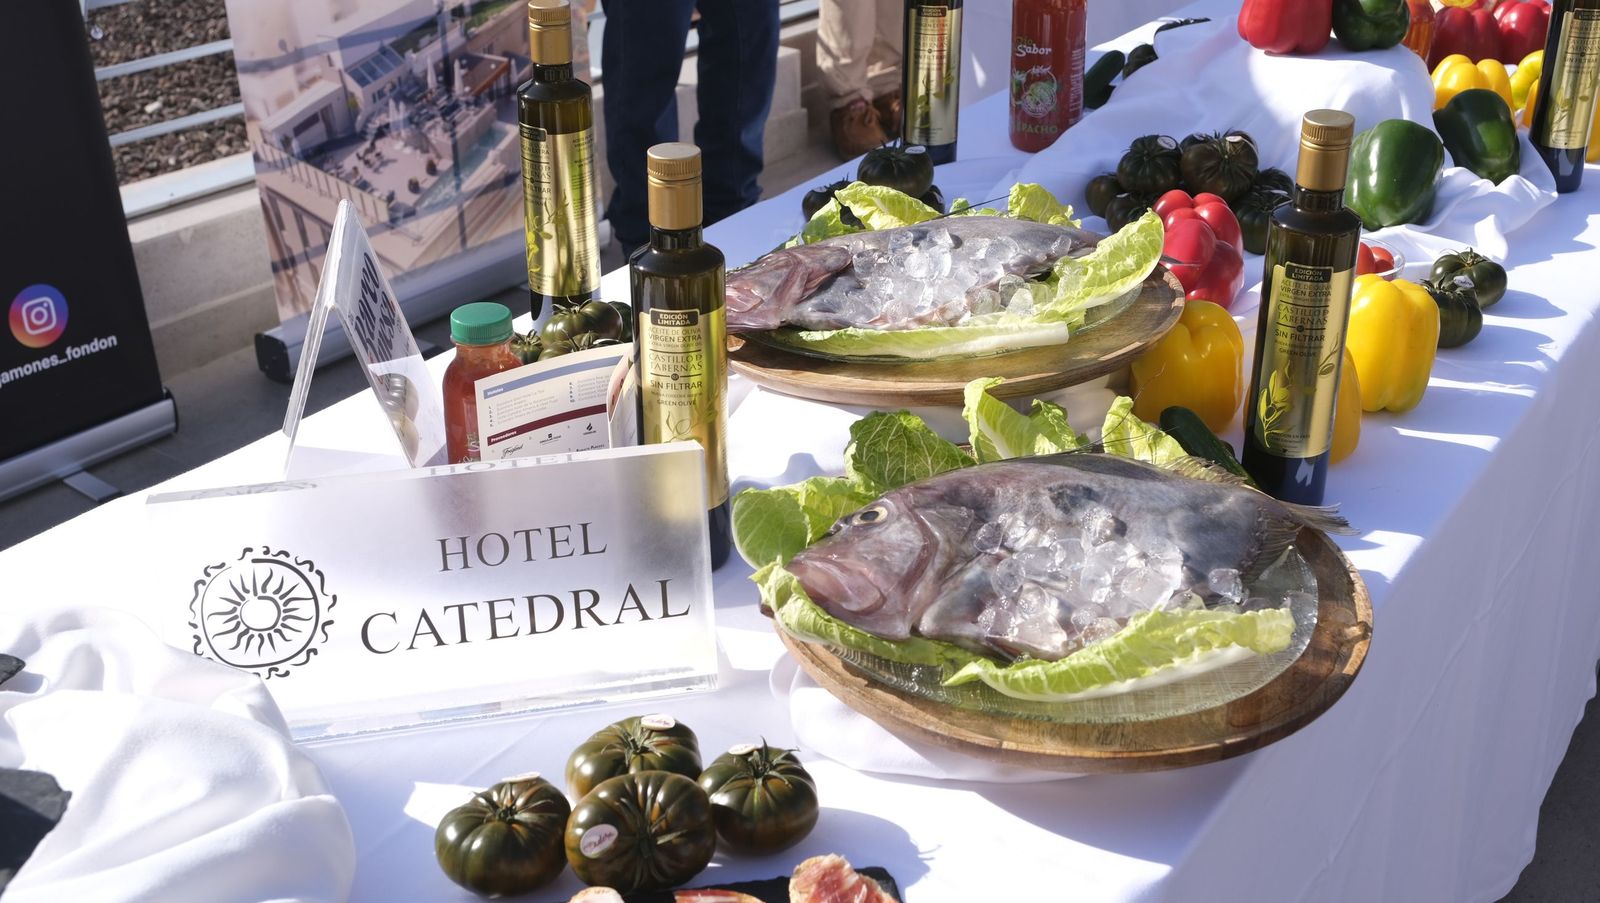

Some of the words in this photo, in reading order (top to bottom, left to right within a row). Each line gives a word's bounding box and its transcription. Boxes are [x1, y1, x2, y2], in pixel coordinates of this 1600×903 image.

[1015, 44, 1053, 57] Sabor
[1291, 273, 1324, 281] LIMITADA
[1294, 268, 1323, 276] EDICIÓN
[1281, 286, 1306, 296] VIRGEN
[1277, 303, 1320, 316] CASTILLO
[659, 312, 688, 320] EDICIÓN
[1278, 312, 1328, 325] TABERNAS
[681, 327, 702, 335] OLIVA
[1275, 329, 1288, 338] SIN
[1290, 333, 1325, 342] FILTRAR
[649, 334, 675, 343] VIRGEN
[677, 334, 702, 342] EXTRA
[1279, 347, 1298, 356] GREEN
[0, 335, 118, 388] amones_fondon
[648, 353, 693, 363] CASTILLO
[650, 361, 703, 373] TABERNAS
[650, 380, 664, 390] SIN
[666, 380, 703, 391] FILTRAR
[436, 522, 608, 572] HOTEL
[360, 578, 691, 655] CATEDRAL
